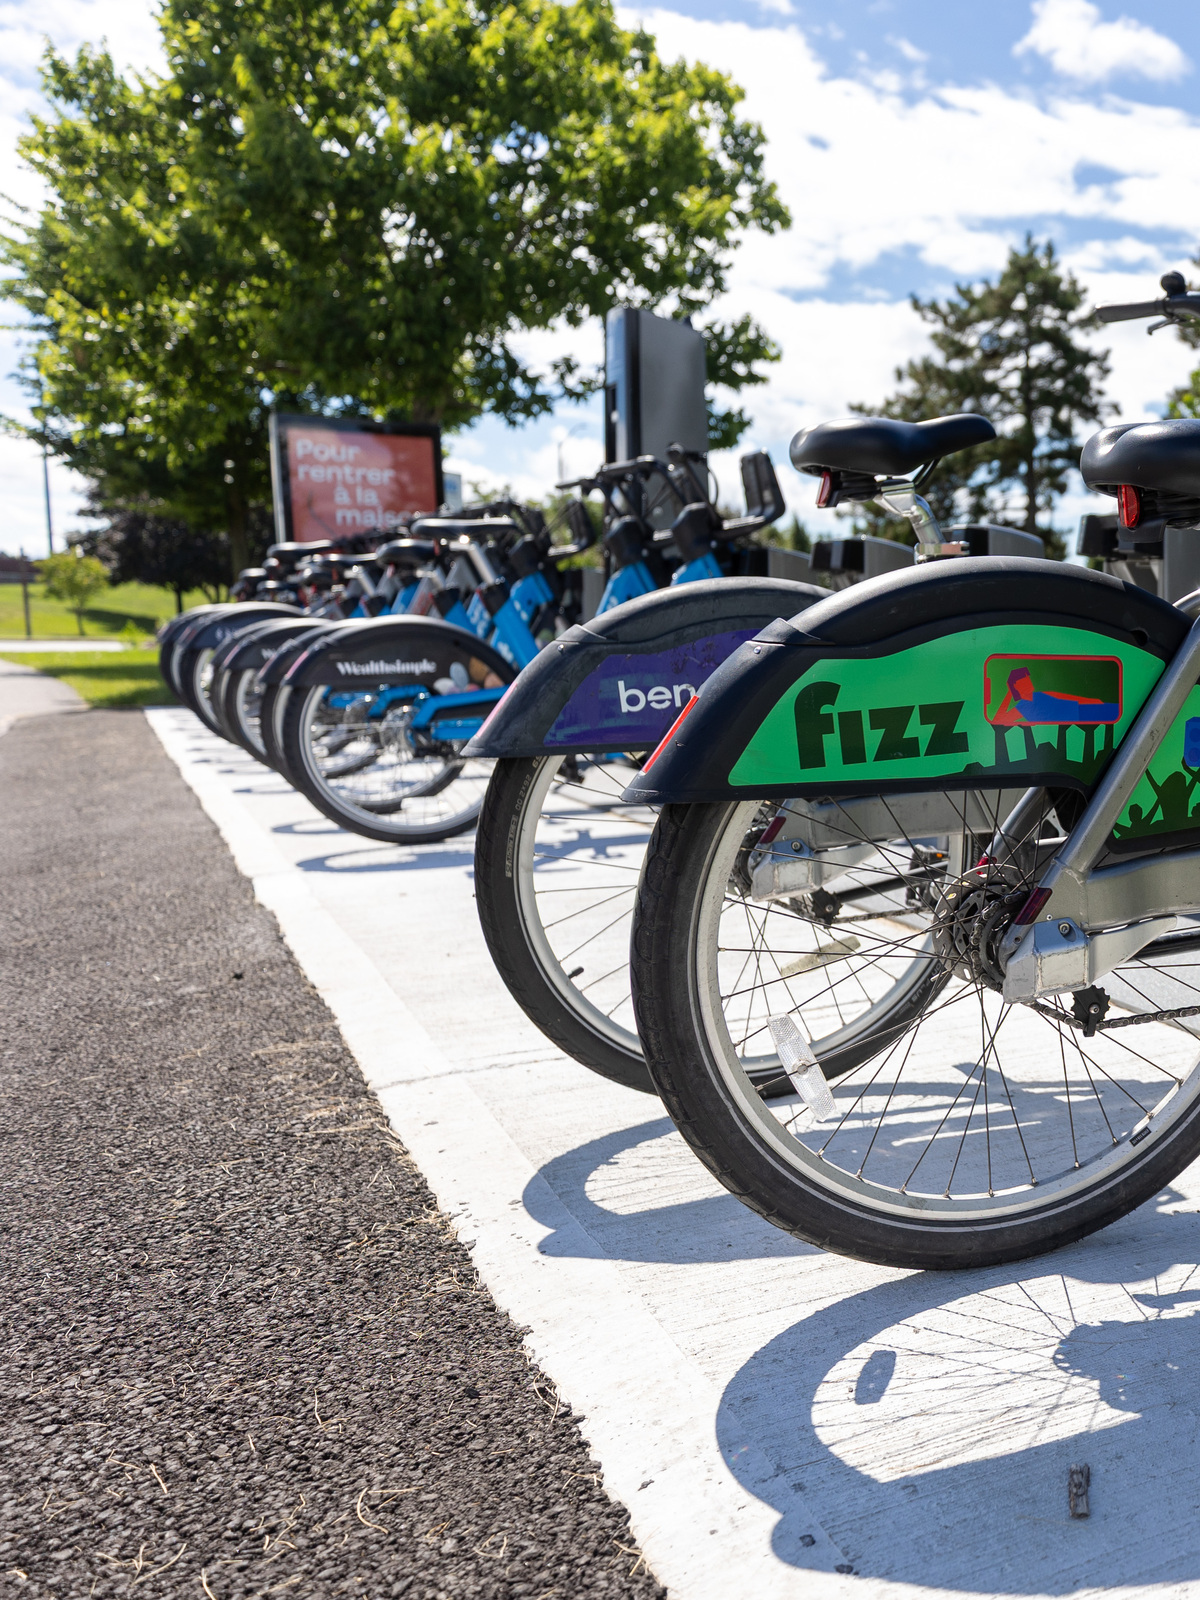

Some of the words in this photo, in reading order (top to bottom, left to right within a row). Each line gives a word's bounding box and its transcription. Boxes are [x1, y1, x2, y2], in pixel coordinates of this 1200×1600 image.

[296, 438, 361, 463] Pour
[297, 463, 396, 487] rentrer
[356, 484, 380, 507] la
[336, 658, 438, 677] Wealthsimple
[617, 680, 696, 713] ben
[794, 681, 969, 769] fizz
